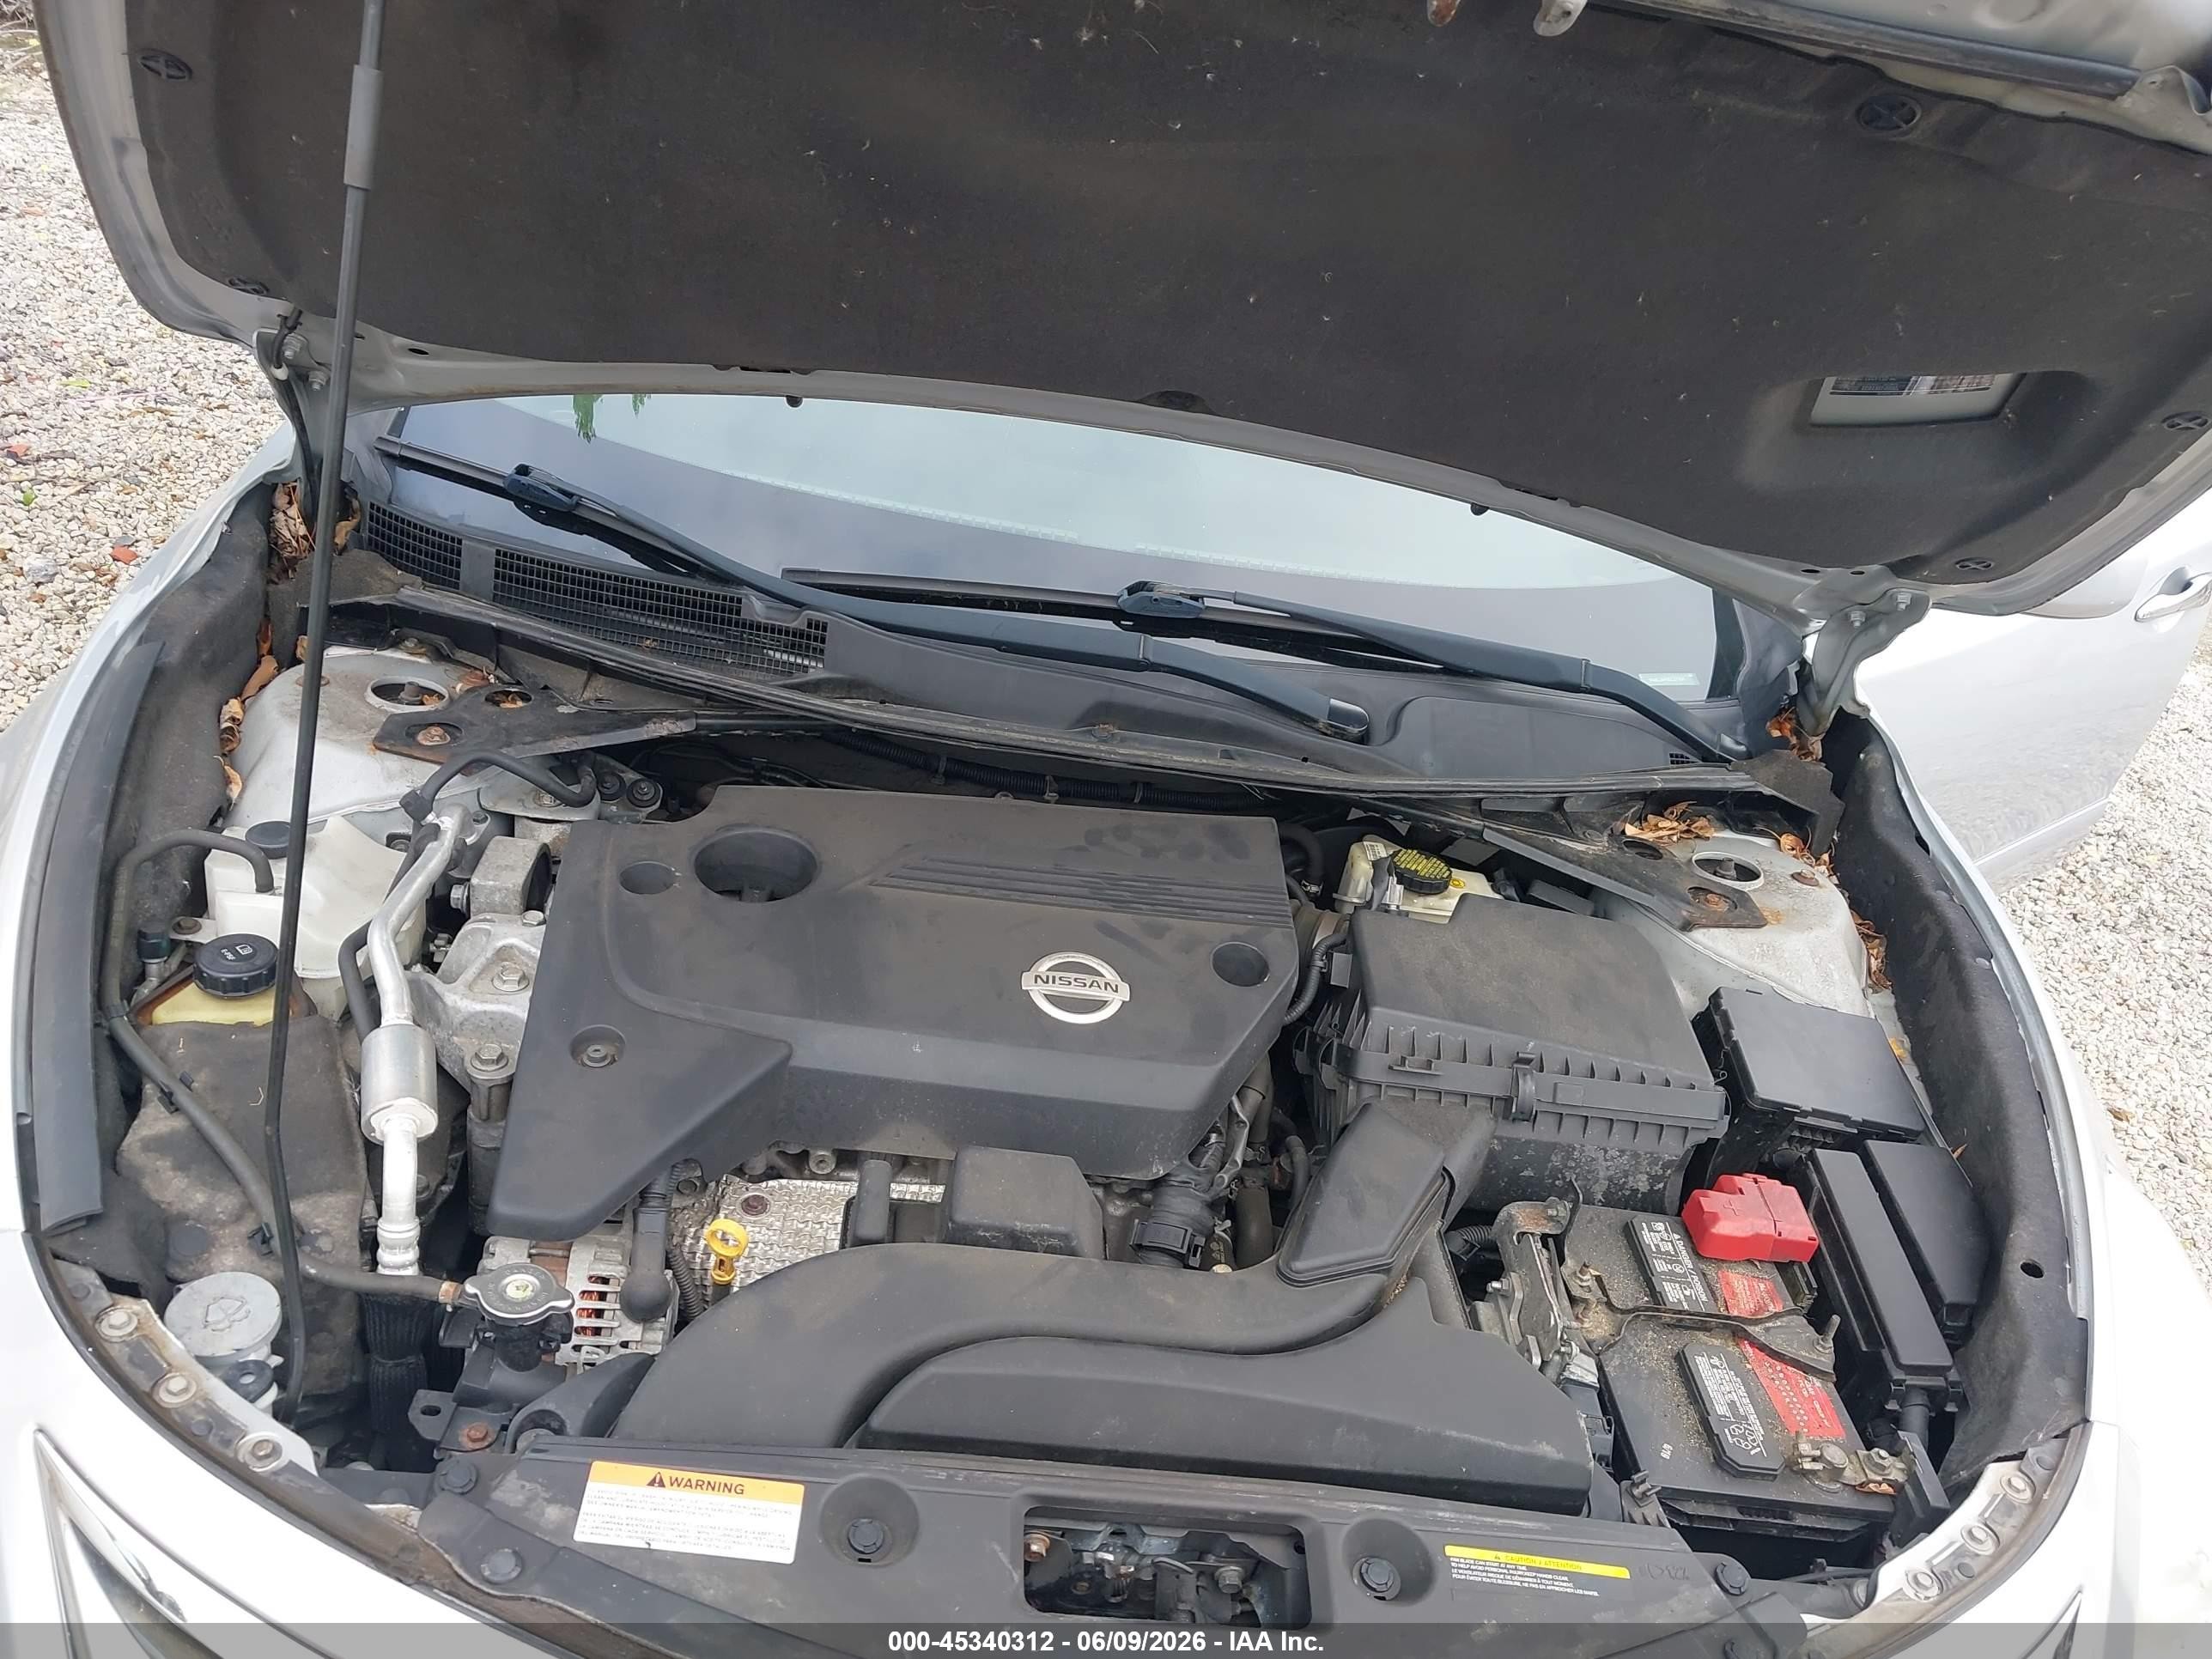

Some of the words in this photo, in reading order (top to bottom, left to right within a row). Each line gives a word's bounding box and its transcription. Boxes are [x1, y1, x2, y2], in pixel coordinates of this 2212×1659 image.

[1034, 974, 1119, 994] NISSAN
[1676, 1240, 1694, 1269] DANGER
[1691, 1275, 1709, 1302] POISON
[669, 1475, 744, 1495] WARNING
[1504, 1555, 1535, 1565] CAUTION
[1544, 1560, 1582, 1571] ATTENTION
